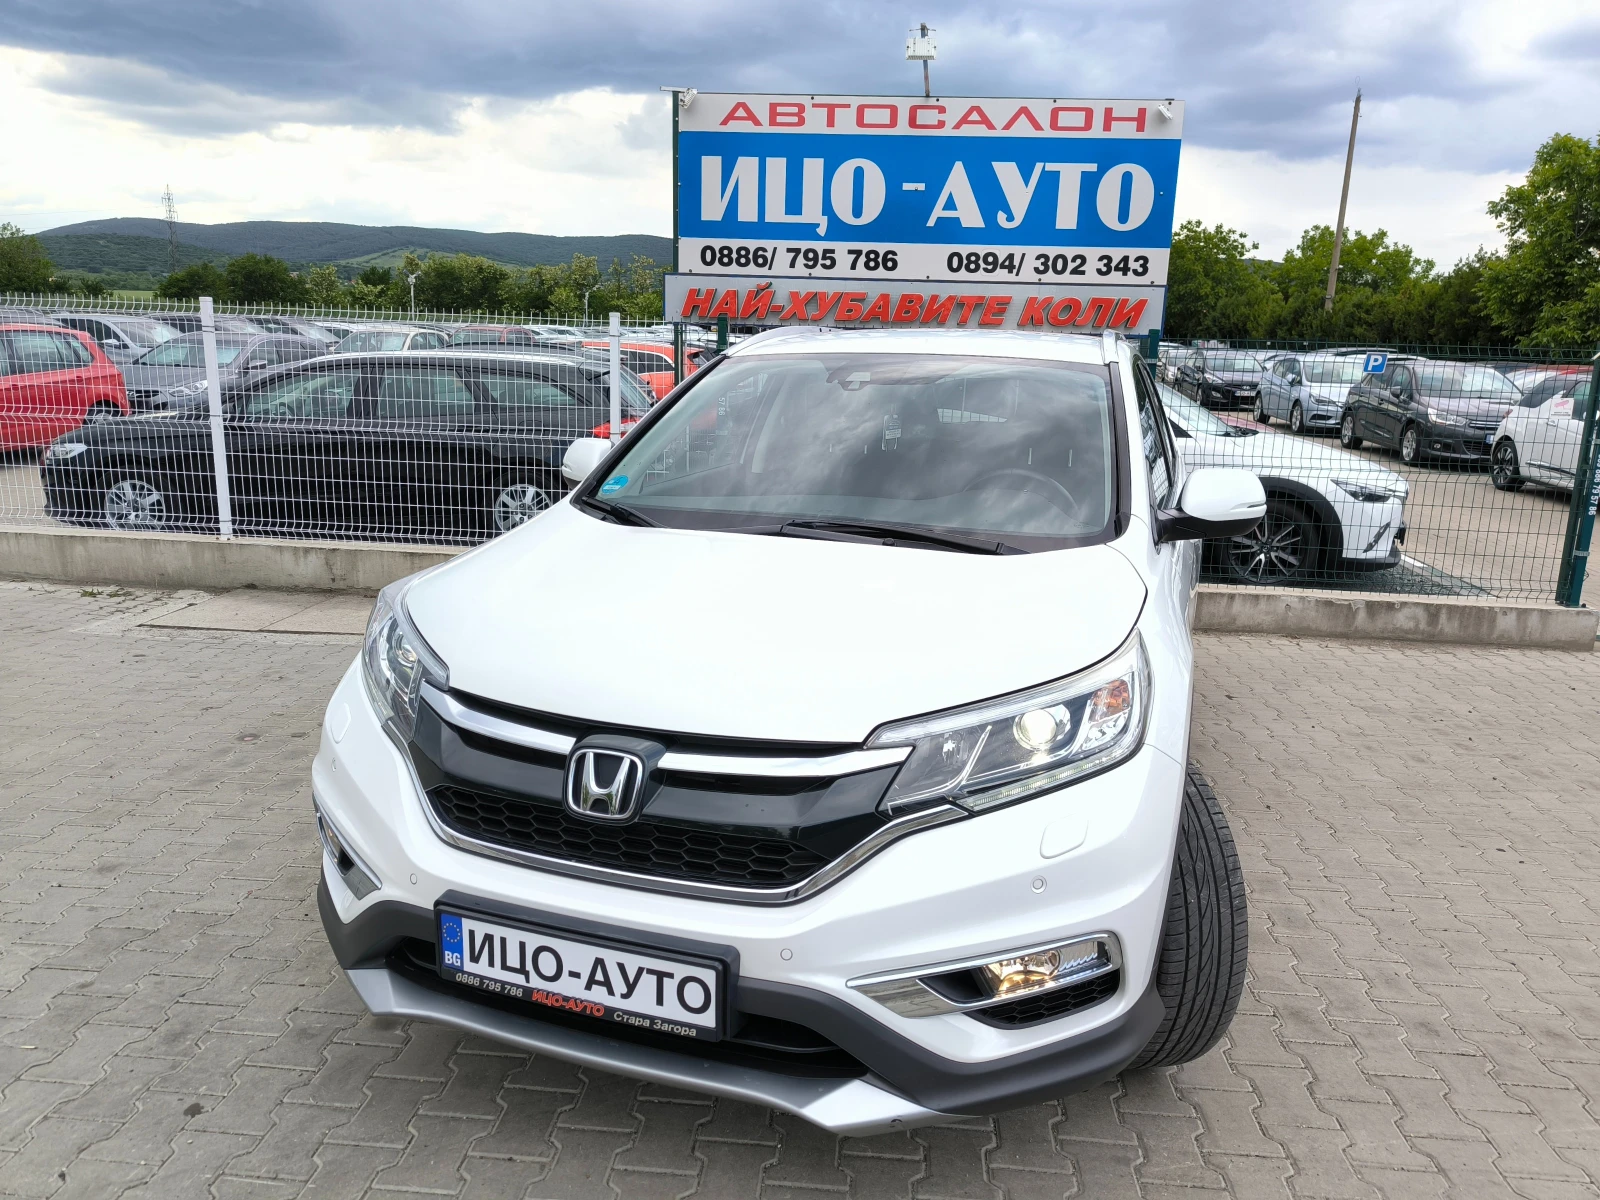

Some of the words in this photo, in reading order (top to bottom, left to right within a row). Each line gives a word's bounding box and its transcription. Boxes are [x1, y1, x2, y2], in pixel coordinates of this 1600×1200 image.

[719, 101, 1147, 133] АВТОСАЛОН
[700, 245, 777, 270] 0886/
[786, 247, 837, 270] 795
[847, 249, 899, 272] 786
[946, 251, 1026, 276] 0894/
[1033, 253, 1087, 276] 302
[1096, 255, 1150, 277] 343
[680, 281, 1013, 325] НАЙ-ХУБАВИТЕ
[1017, 296, 1149, 328] КОЛИ
[1367, 355, 1383, 371] P
[1588, 506, 1598, 516] 86
[1590, 495, 1599, 505] 57
[444, 950, 461, 967] BG
[468, 928, 712, 1015] ИЦО-АУТО
[455, 973, 480, 986] 0886
[483, 980, 501, 992] 795
[504, 984, 523, 997] 786
[531, 988, 605, 1017] ИЦО-АУТО
[613, 1011, 650, 1027] Стара
[653, 1020, 697, 1037] Загора
